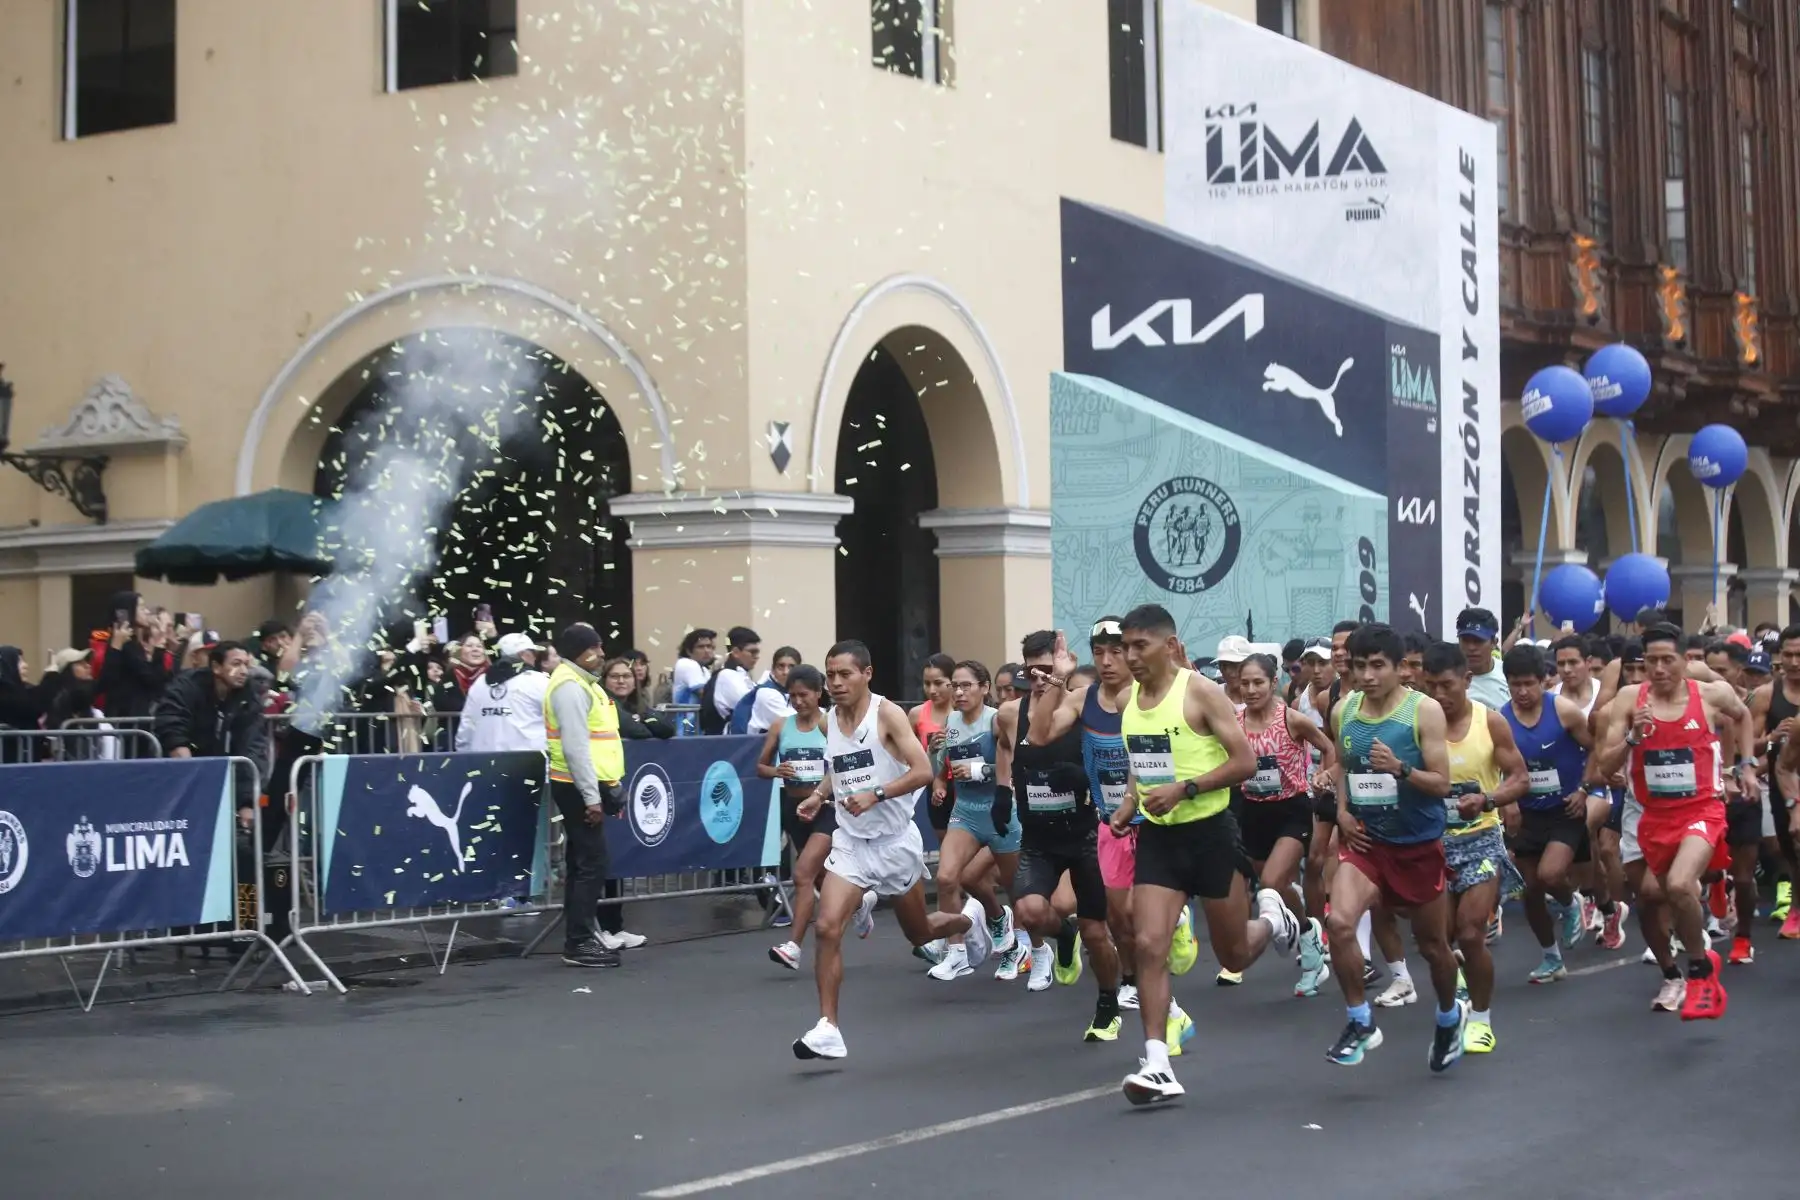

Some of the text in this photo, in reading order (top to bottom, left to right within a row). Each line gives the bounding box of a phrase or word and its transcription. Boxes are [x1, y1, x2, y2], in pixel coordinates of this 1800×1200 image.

[1205, 102, 1257, 119] KIA
[1205, 115, 1388, 184] LIMA
[1237, 184, 1279, 197] MEDIA
[1345, 208, 1381, 221] PUMA
[1091, 293, 1264, 350] KIA
[1391, 355, 1437, 406] LIMA
[1459, 147, 1482, 610] ORAZÓN Y CALLE
[1137, 478, 1238, 527] PERU RUNNERS
[1397, 495, 1435, 525] KIA
[1168, 577, 1206, 593] 1984
[1133, 761, 1168, 769] CALIZAYA
[841, 774, 871, 786] PACHECO
[176, 819, 189, 829] DE
[106, 832, 190, 872] LIMA
